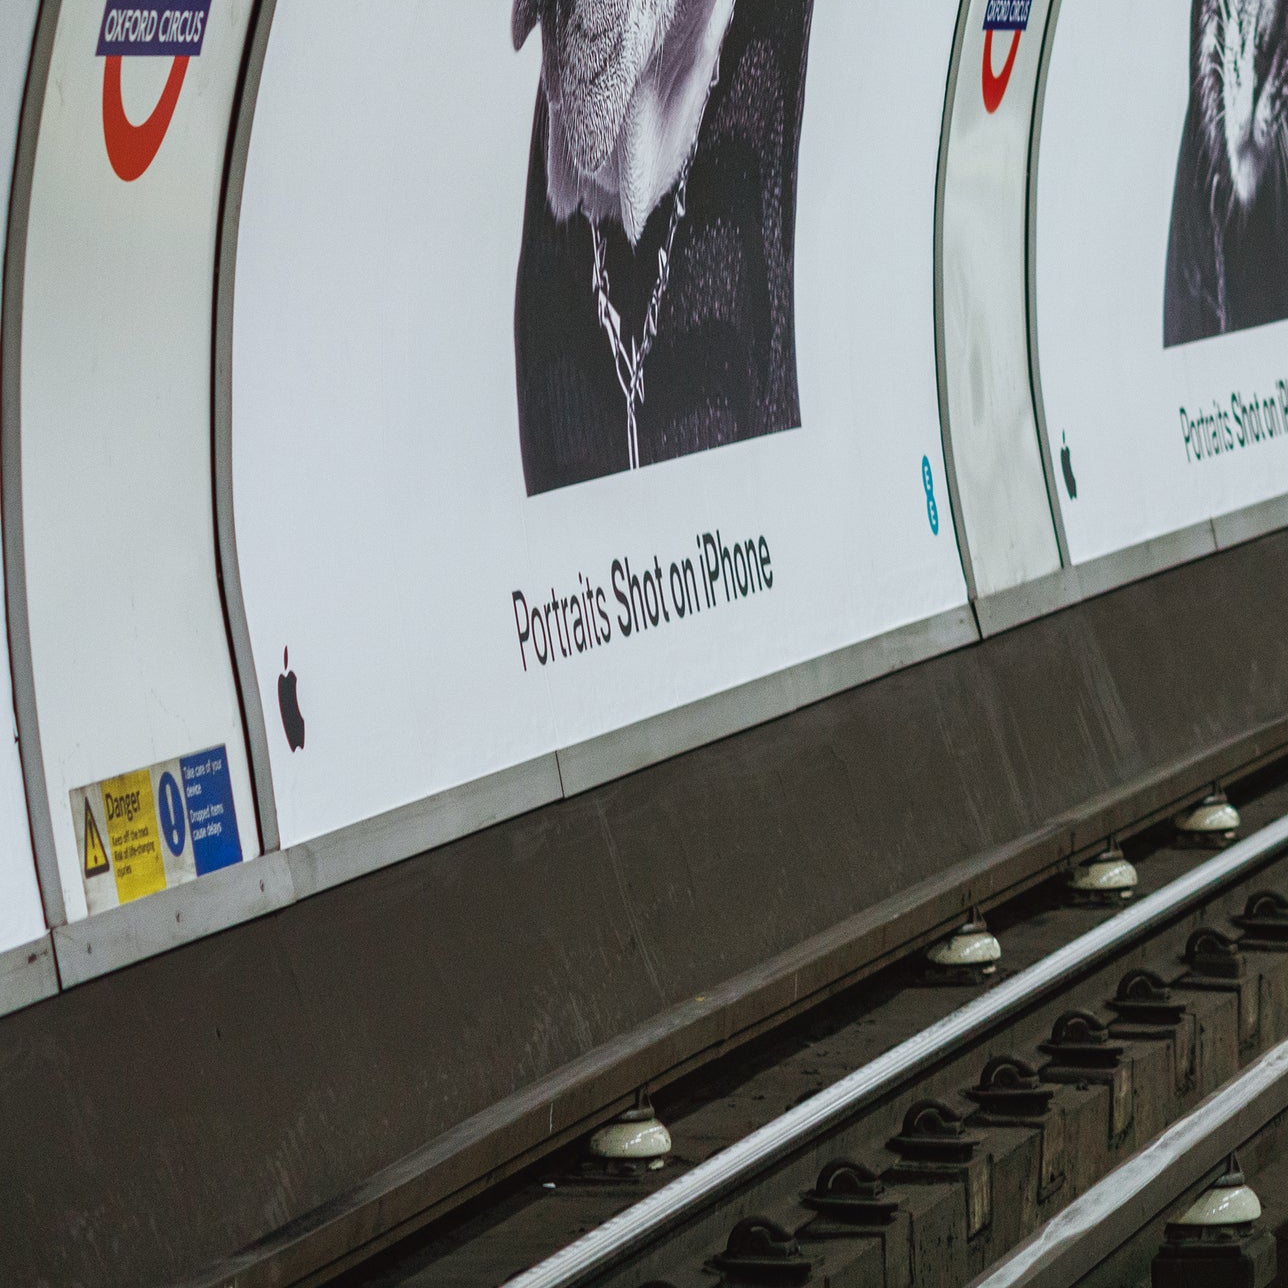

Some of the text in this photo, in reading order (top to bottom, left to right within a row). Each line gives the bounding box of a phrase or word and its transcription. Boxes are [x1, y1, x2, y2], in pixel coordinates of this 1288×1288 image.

[986, 0, 1030, 22] OXFORD CIRCUS
[104, 9, 204, 43] OXFORD CIRCUS
[1179, 399, 1234, 463] Portraits
[1231, 390, 1266, 447] Shot
[1263, 397, 1282, 438] on
[511, 529, 774, 672] Portraits Shot on iPhone
[183, 766, 195, 780] Take
[187, 784, 202, 798] device
[105, 790, 141, 821] Danger
[190, 806, 211, 824] Dropped
[206, 822, 222, 838] delays
